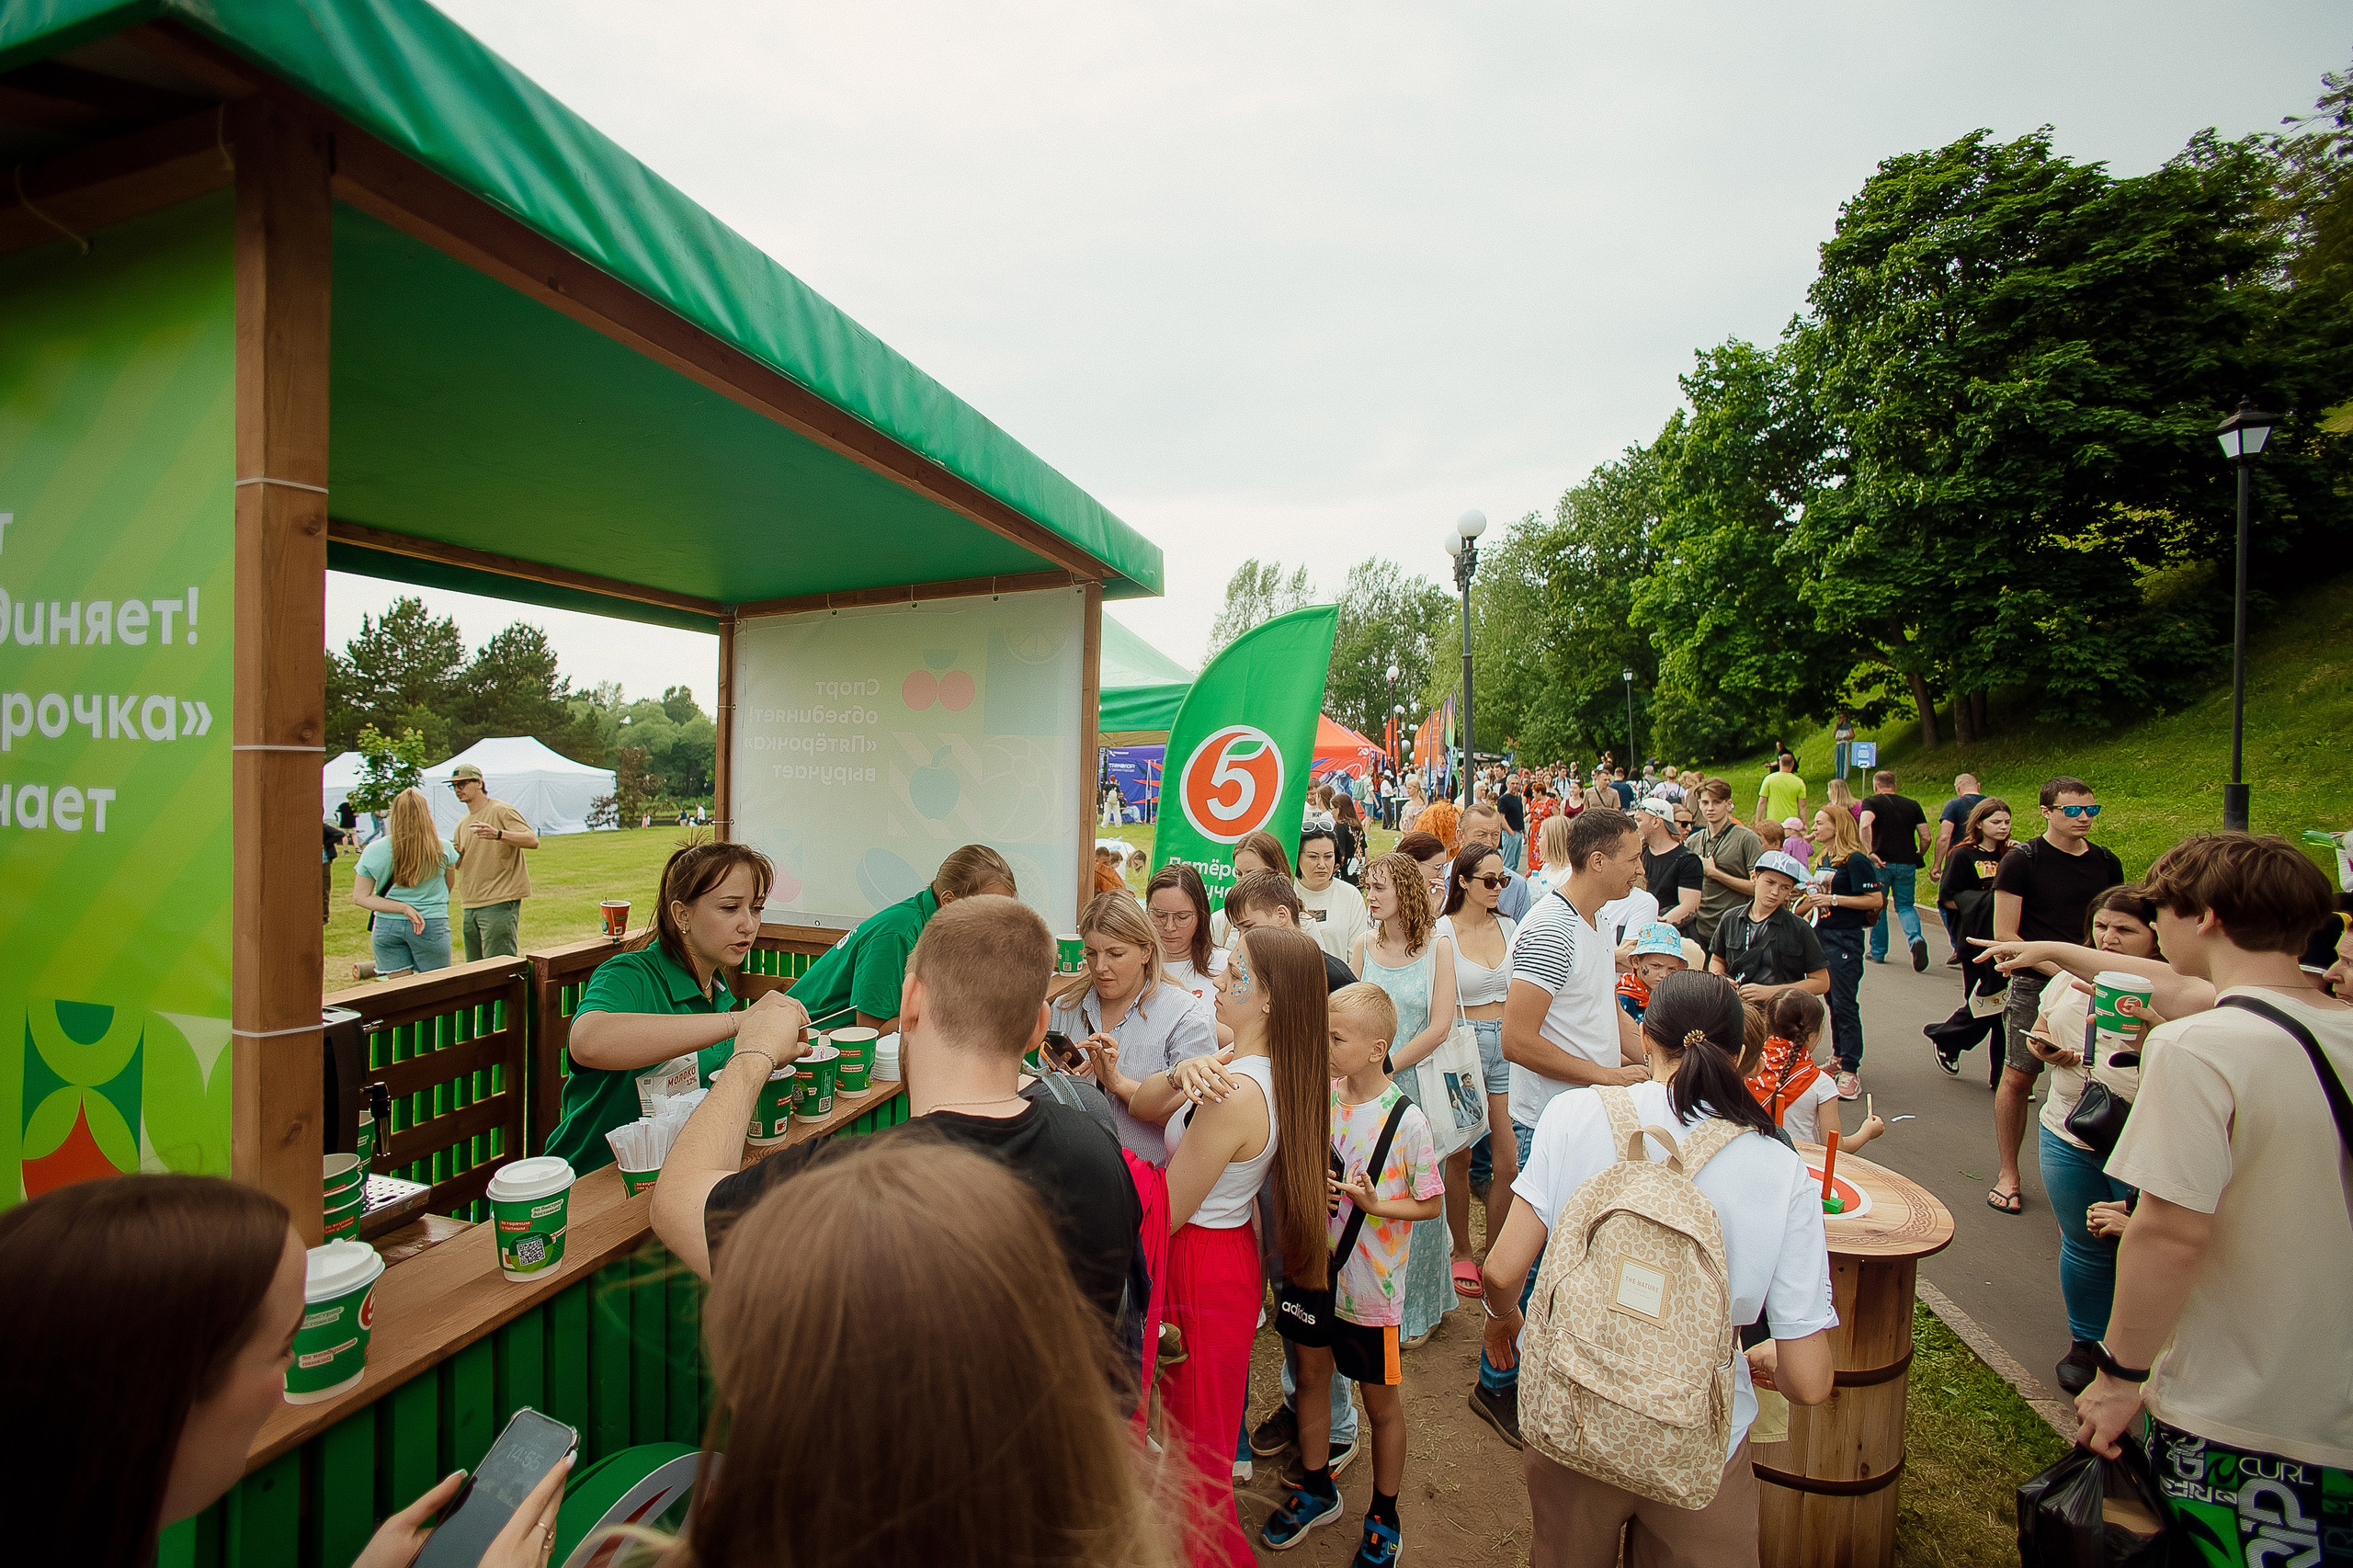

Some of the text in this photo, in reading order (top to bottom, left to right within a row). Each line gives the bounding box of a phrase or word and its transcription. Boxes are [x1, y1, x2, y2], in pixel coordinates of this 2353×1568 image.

[667, 1065, 697, 1088] МОЛОКО
[1625, 1275, 1636, 1285] THE
[1636, 1279, 1660, 1294] NATURE
[1281, 1301, 1316, 1325] adidas
[2239, 1457, 2314, 1485] CURL
